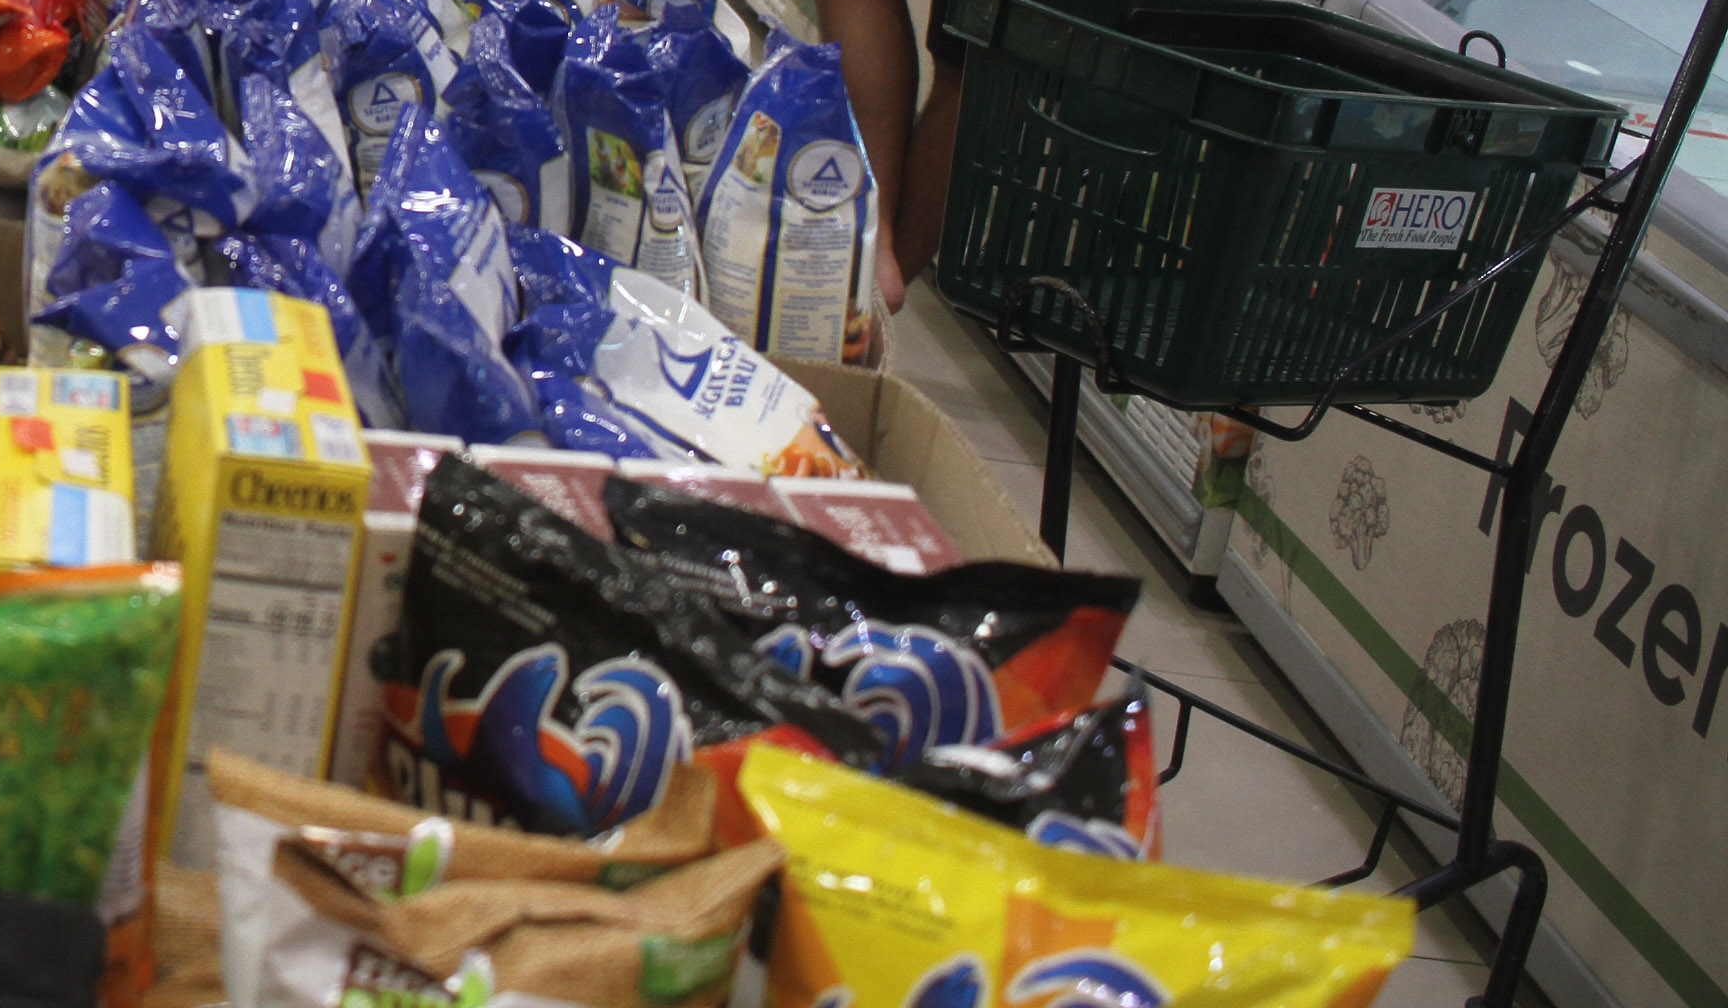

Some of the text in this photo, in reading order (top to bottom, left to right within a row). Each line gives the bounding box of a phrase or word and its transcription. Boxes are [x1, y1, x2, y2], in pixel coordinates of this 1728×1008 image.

[1389, 194, 1467, 231] HERO
[1360, 228, 1458, 248] The Fresh Food People
[724, 353, 758, 407] BIRU
